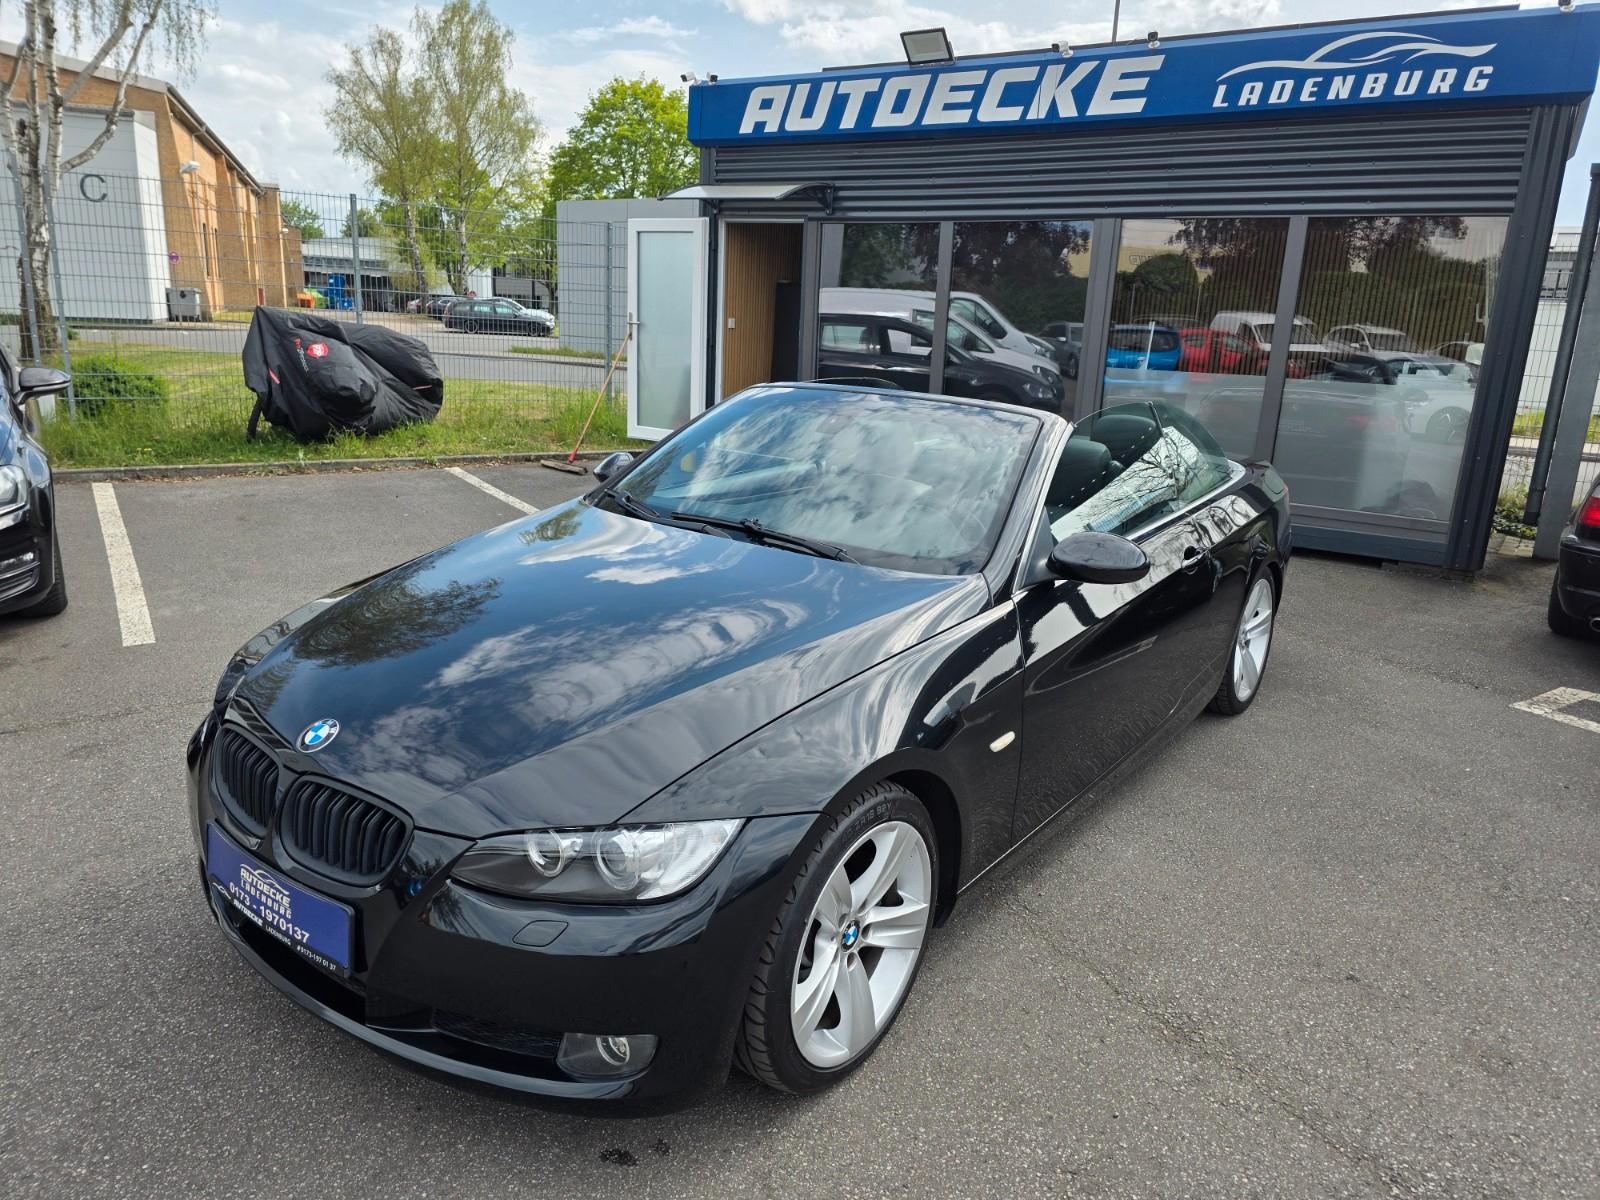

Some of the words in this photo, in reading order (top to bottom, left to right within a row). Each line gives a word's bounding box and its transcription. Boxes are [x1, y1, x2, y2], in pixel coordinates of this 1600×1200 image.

[739, 55, 1164, 135] AUTOECKE
[1212, 65, 1494, 108] LADENBURG
[80, 174, 107, 203] C
[241, 868, 290, 907] AUTOECKE
[241, 880, 292, 919] LADENBURG
[230, 882, 250, 905] 0173
[260, 906, 310, 943] 1970137
